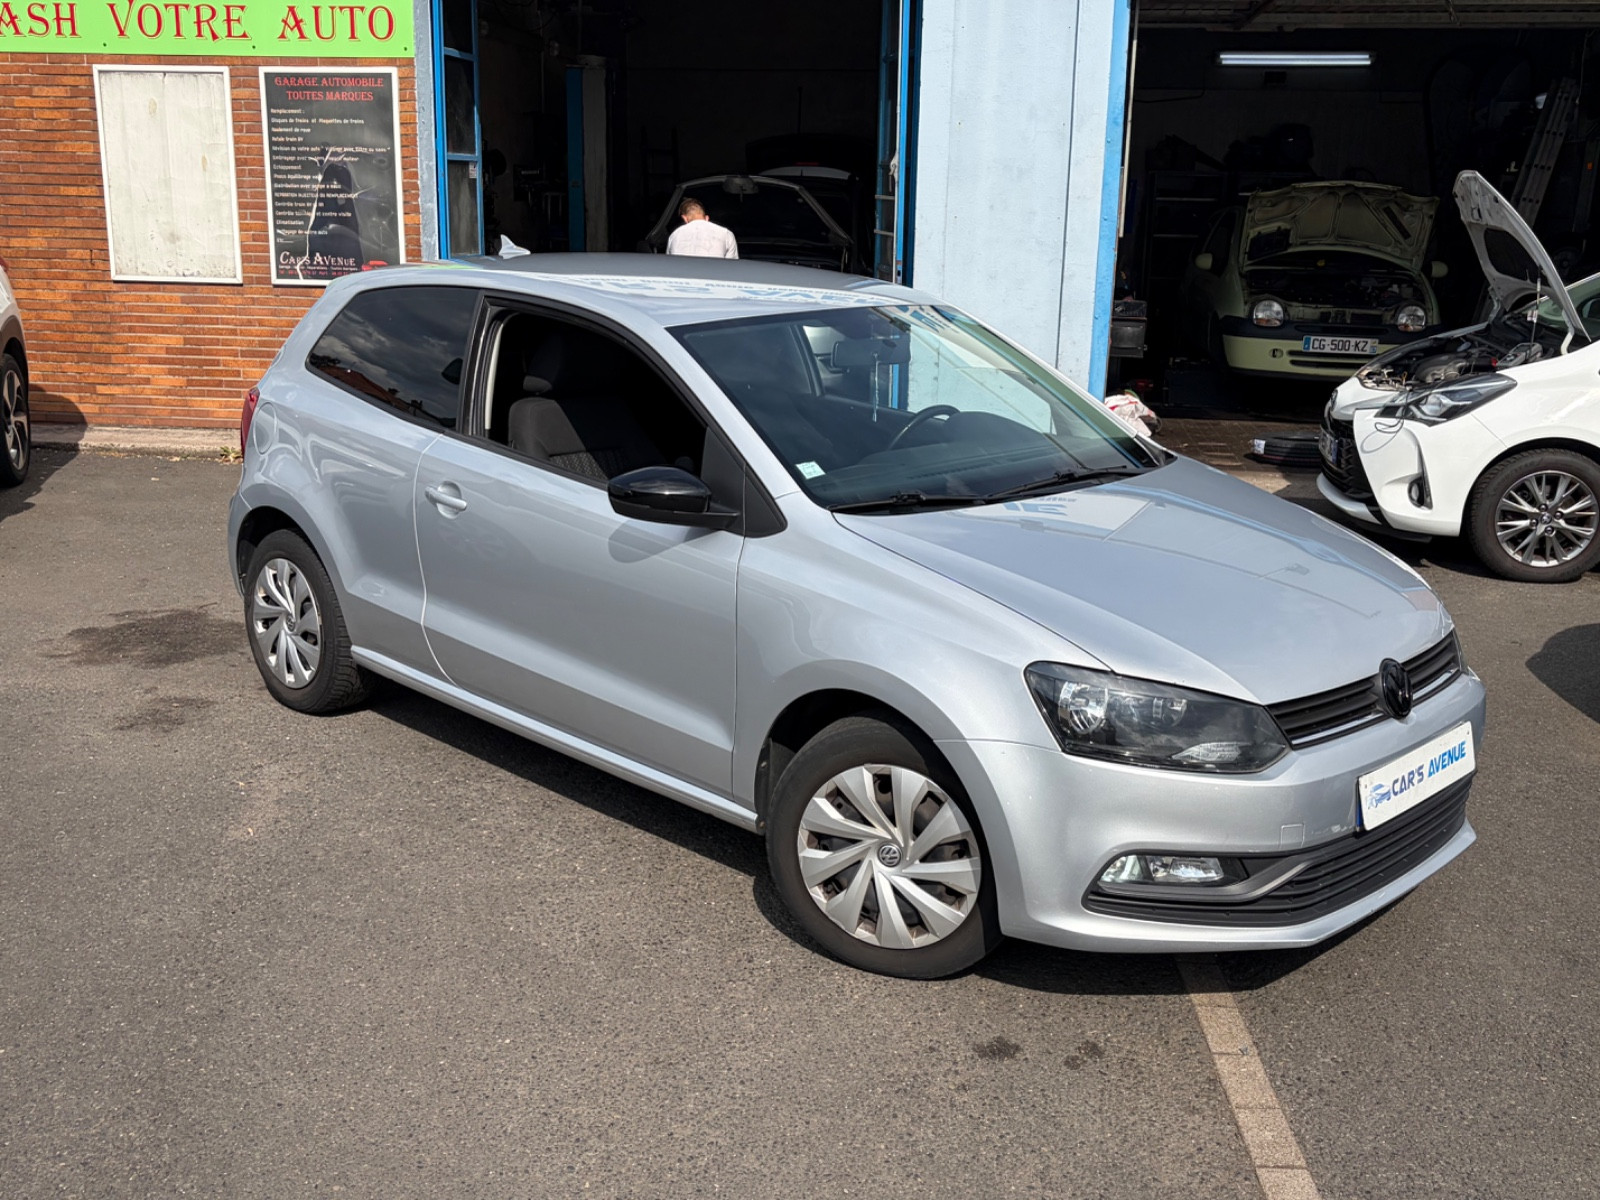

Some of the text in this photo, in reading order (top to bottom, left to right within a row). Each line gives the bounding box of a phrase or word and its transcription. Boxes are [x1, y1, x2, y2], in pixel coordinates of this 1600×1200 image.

[106, 0, 252, 42] VOTRE
[277, 5, 397, 41] AUTO
[274, 76, 384, 87] GARAGE AUTOMOBILE
[286, 90, 374, 101] TOUTES MARQUES
[313, 252, 356, 266] AVENUE
[1392, 741, 1466, 796] CAR'S AVENUE
